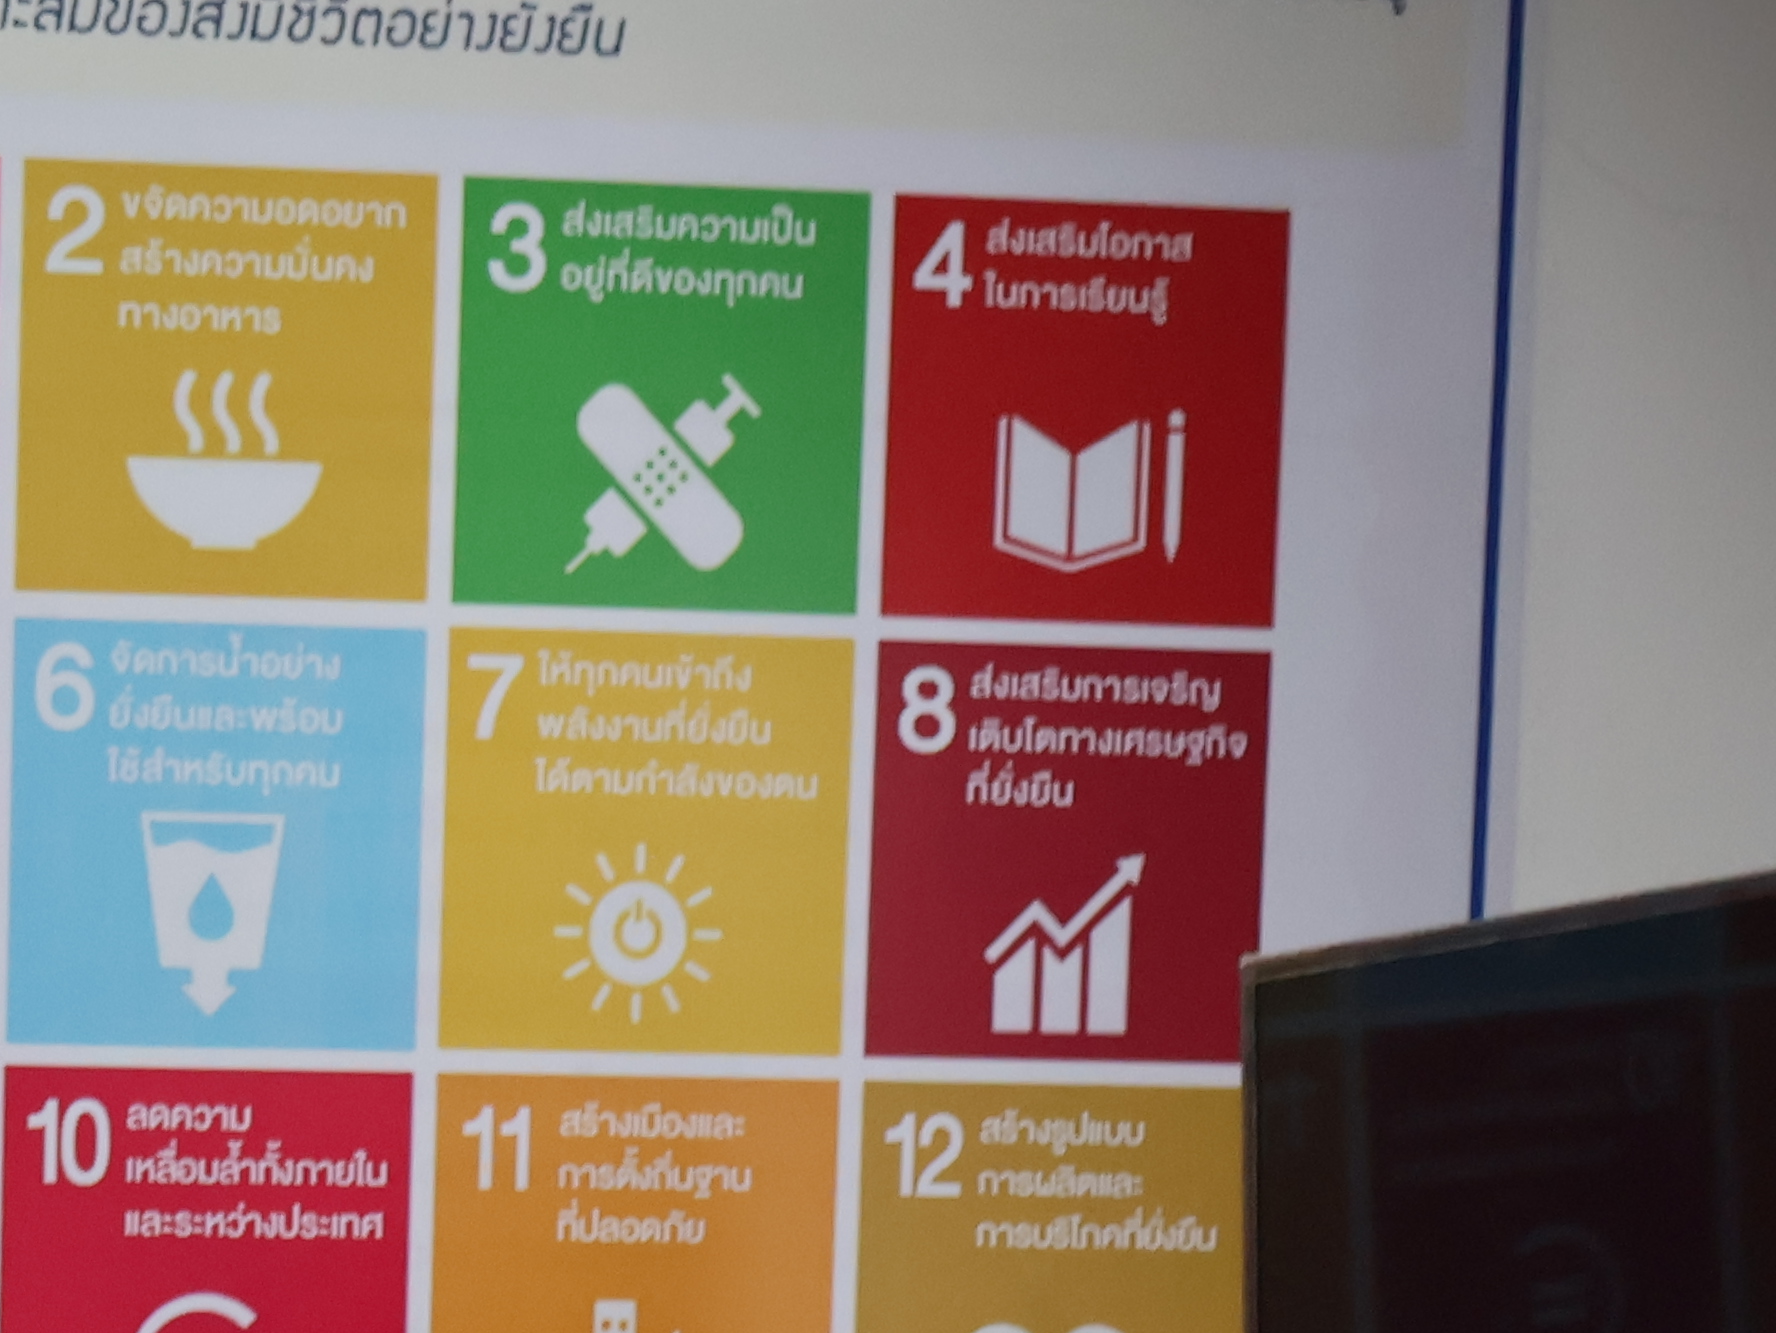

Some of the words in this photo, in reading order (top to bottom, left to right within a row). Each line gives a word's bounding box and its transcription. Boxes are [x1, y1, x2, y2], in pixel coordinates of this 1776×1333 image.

[44, 183, 105, 275] 2
[120, 185, 407, 229] ขจัดความอดอยาก
[560, 199, 817, 248] ส่งเสริมความเป็น
[117, 234, 375, 285] สร้างความมั่นคง
[486, 201, 547, 293] 3
[912, 219, 973, 309] 4
[986, 218, 1194, 265] ส่งเสริมโอกาส
[560, 248, 805, 307] อยู่ที่ดีของทุกคน
[117, 299, 283, 336] ทางอาหาร
[110, 632, 342, 681] จัดการน้ำอย่าง
[34, 641, 96, 733] 6
[107, 684, 344, 737] ยั่งยืนและพร้อม
[466, 653, 524, 741] 7
[896, 664, 957, 754] 8
[25, 1097, 111, 1187] 10
[126, 1102, 251, 1134] ลดความ
[461, 1103, 531, 1192] 11
[882, 1111, 962, 1199] 12
[124, 1200, 384, 1242] และระหว่างประเทศ
